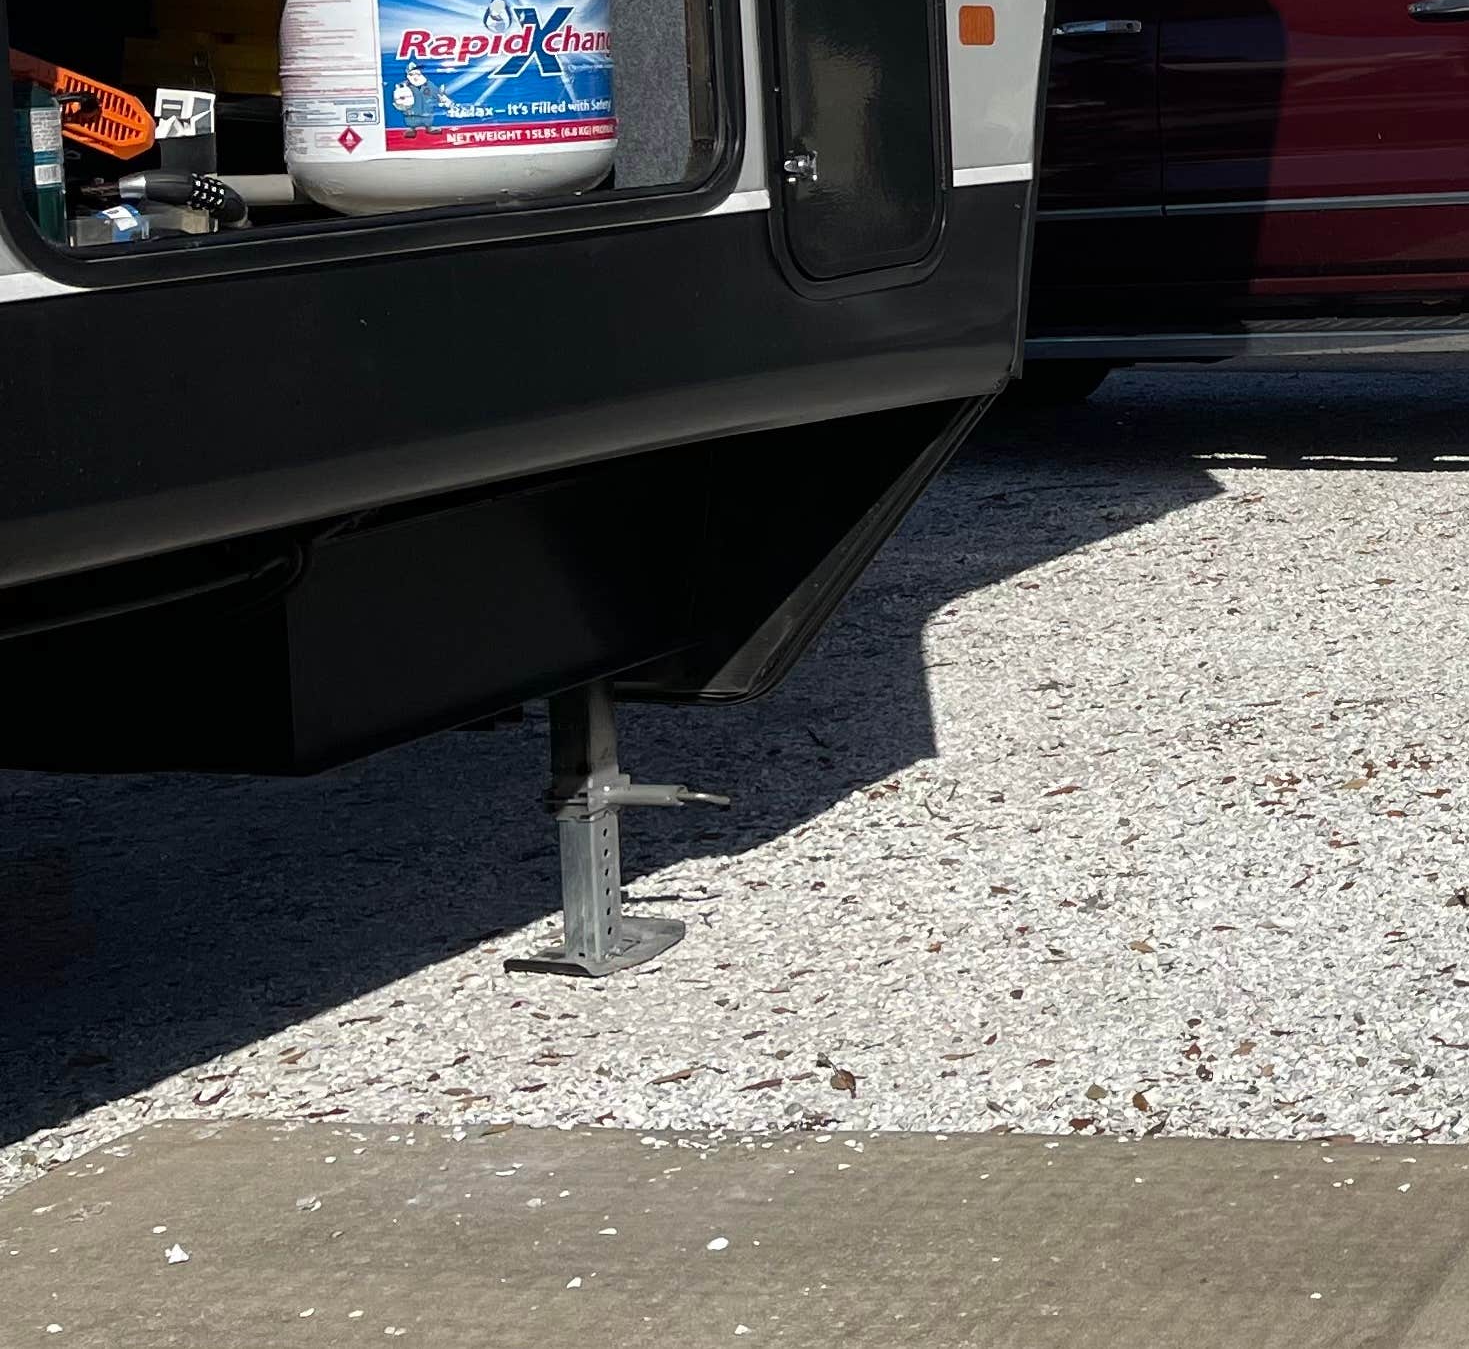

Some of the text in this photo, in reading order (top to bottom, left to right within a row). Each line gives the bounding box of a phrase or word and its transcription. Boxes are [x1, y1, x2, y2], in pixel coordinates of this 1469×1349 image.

[532, 101, 566, 114] Filled
[568, 99, 589, 111] with
[446, 132, 472, 144] NET
[474, 130, 522, 141] WEIGHT
[561, 127, 577, 138] (6.8
